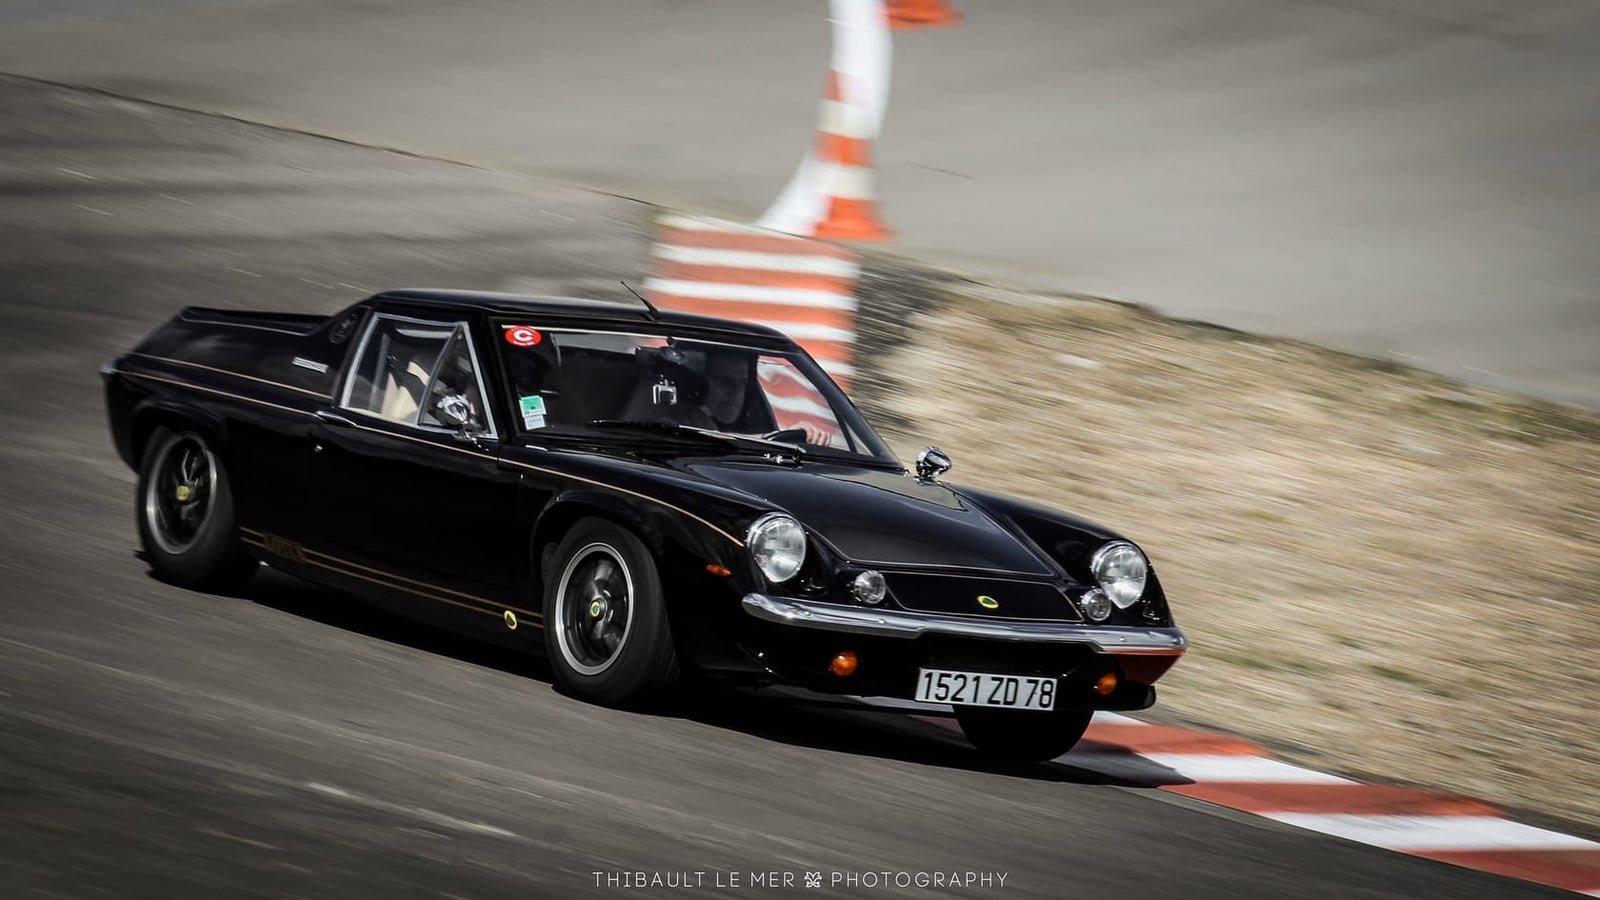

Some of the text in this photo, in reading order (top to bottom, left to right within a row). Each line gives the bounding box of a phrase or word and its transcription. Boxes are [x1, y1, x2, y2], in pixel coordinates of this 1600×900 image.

[924, 671, 1055, 709] 1521 ZD 78
